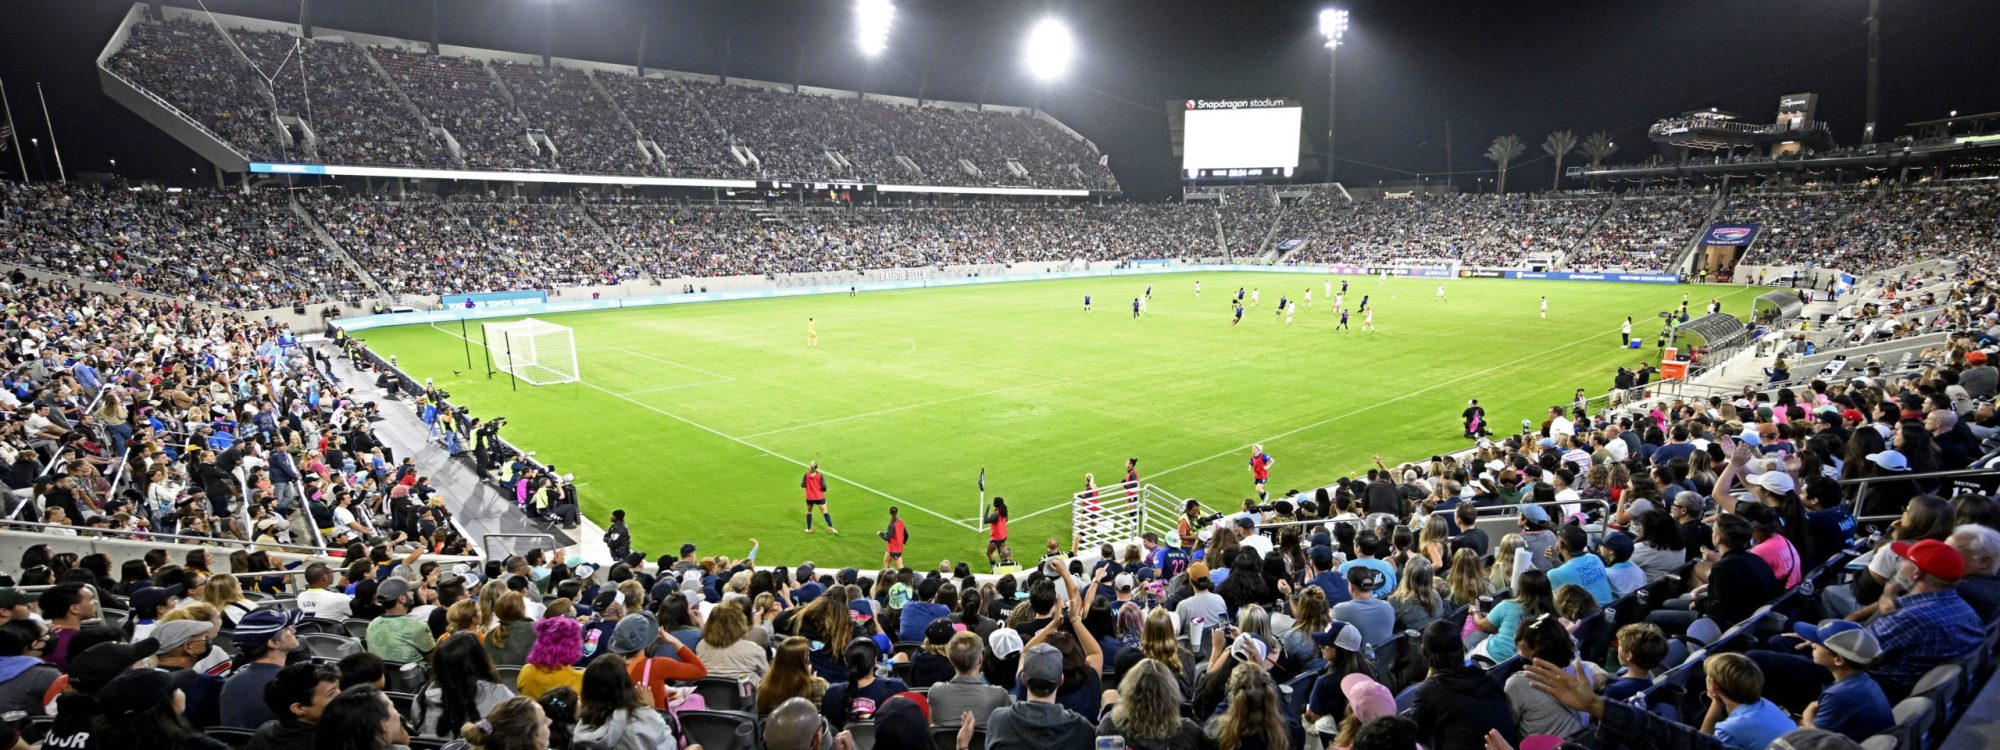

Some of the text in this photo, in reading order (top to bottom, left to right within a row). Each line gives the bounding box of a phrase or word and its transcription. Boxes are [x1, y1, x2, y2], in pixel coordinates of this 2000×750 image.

[1197, 97, 1284, 109] Snapdragon stadium
[1953, 480, 1981, 488] SECTION
